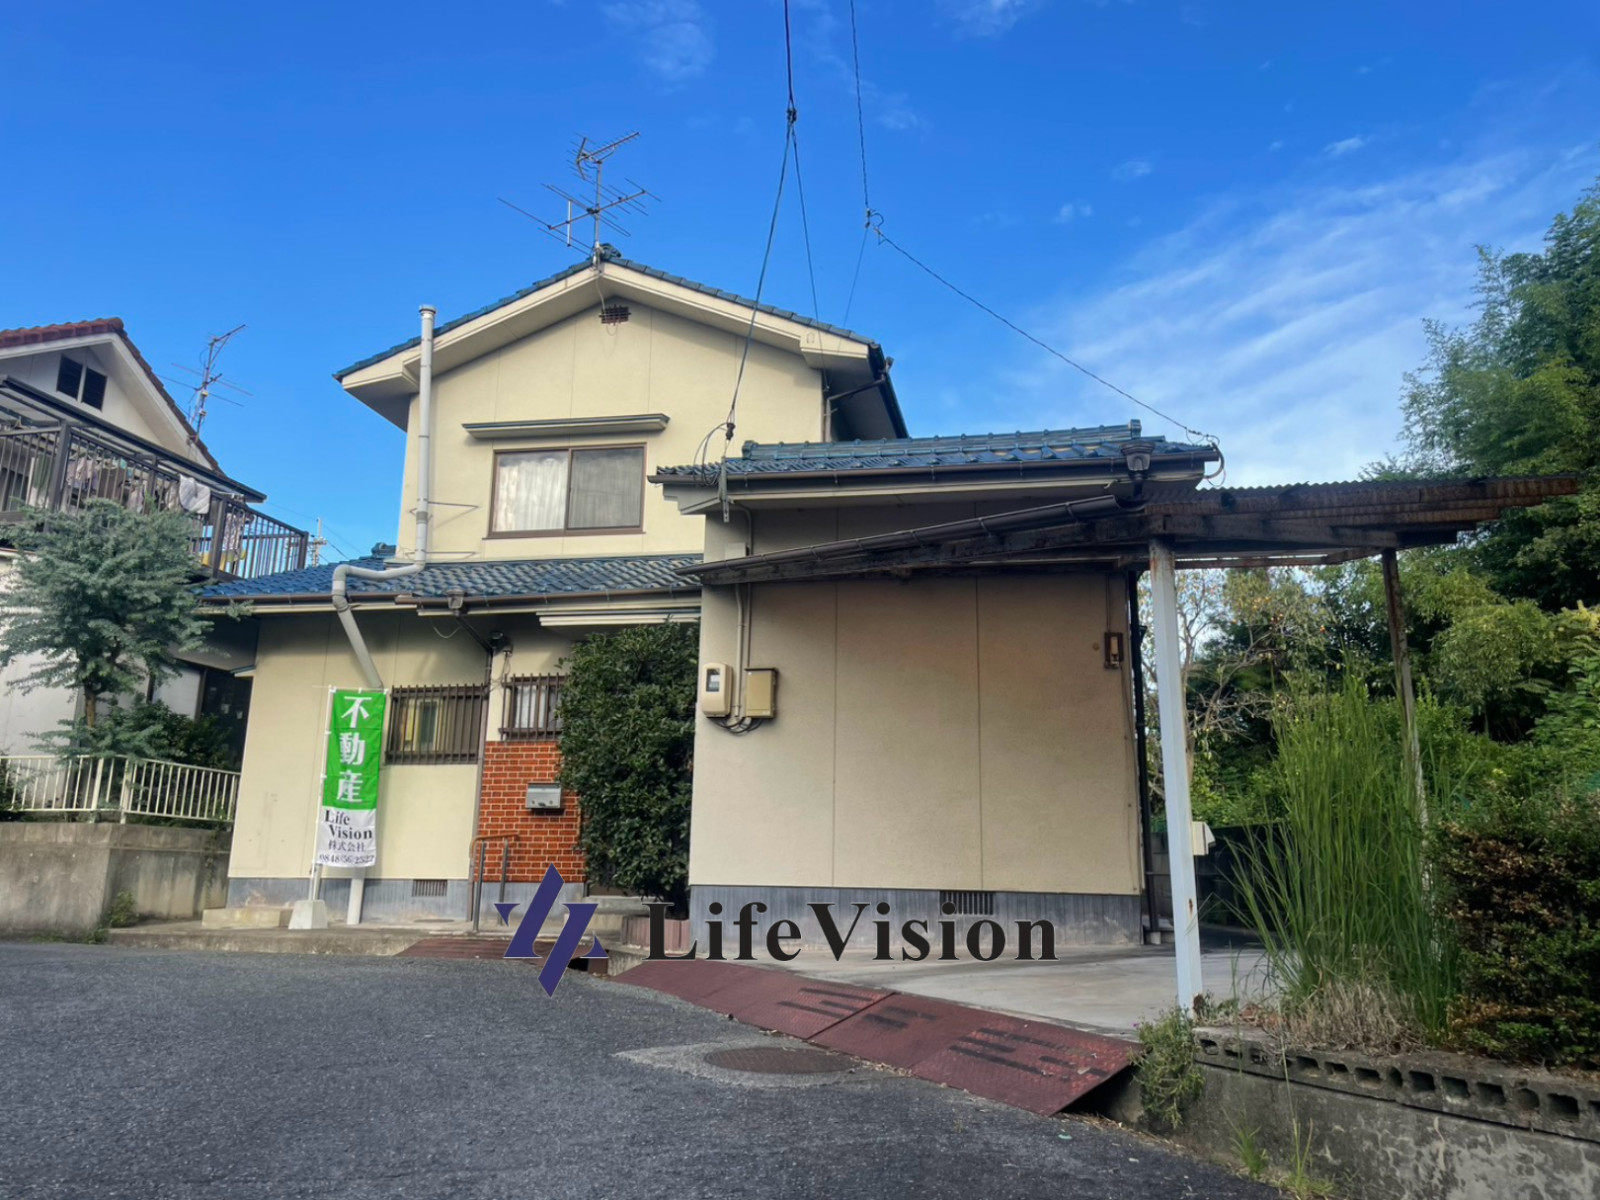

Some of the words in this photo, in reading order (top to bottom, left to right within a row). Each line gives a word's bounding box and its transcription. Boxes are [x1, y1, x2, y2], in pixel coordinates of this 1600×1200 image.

[336, 695, 372, 802] 不動産
[325, 810, 351, 825] Life
[329, 824, 373, 840] Vision
